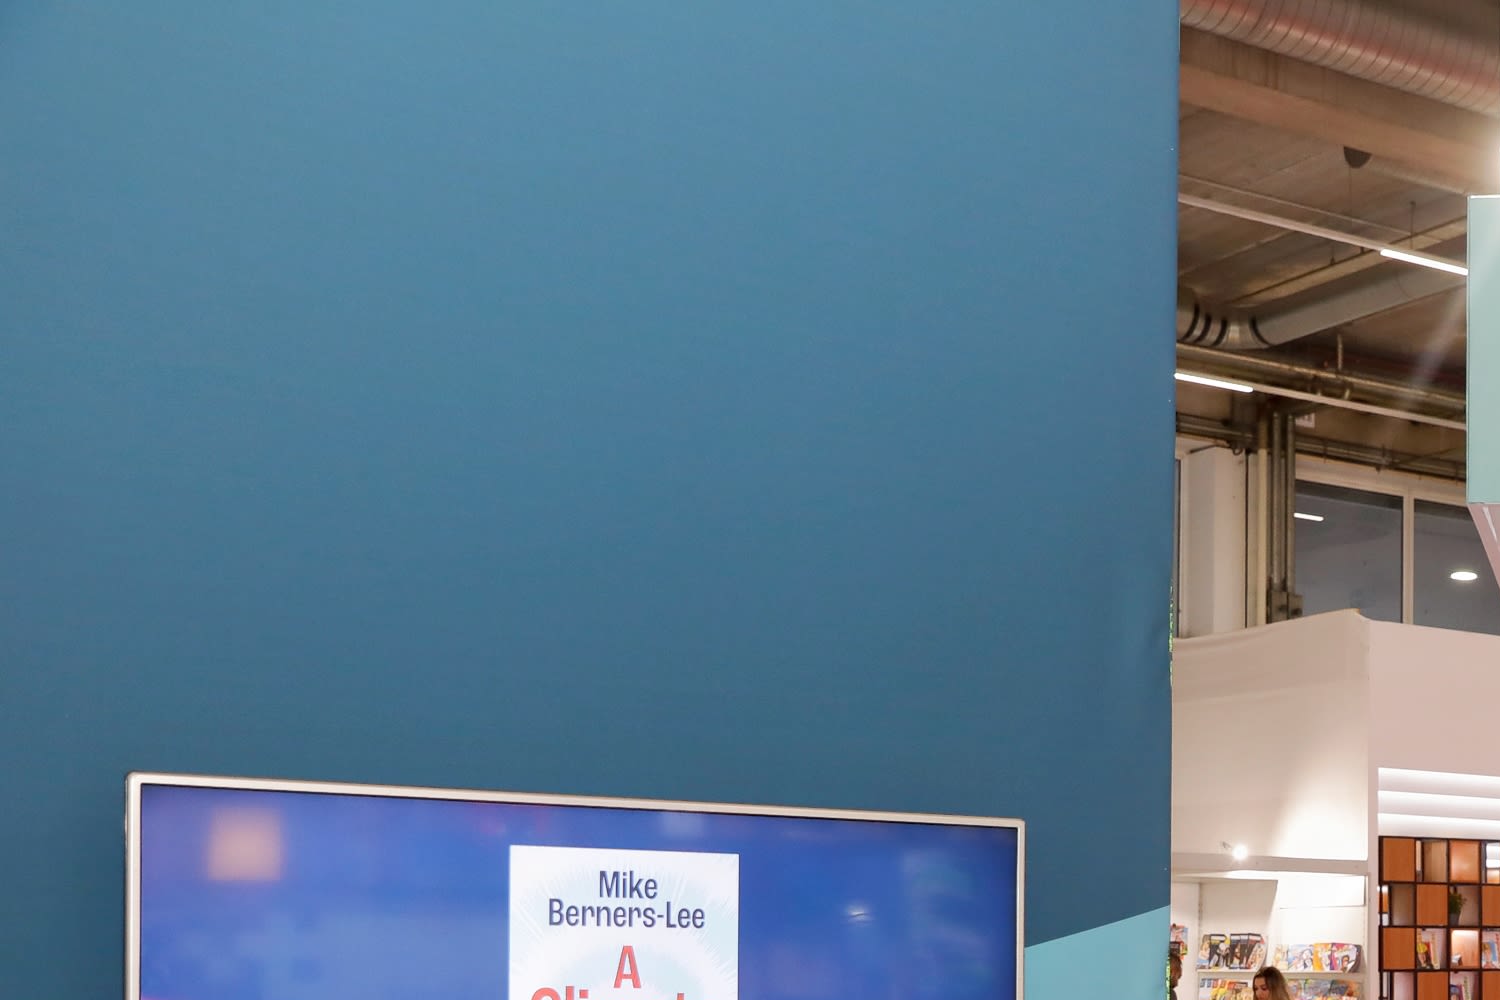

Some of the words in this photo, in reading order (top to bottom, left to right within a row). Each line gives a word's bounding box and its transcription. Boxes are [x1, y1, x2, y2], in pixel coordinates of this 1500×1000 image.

[598, 870, 659, 900] Mike
[548, 898, 706, 929] Berners-Lee
[613, 945, 642, 989] A
